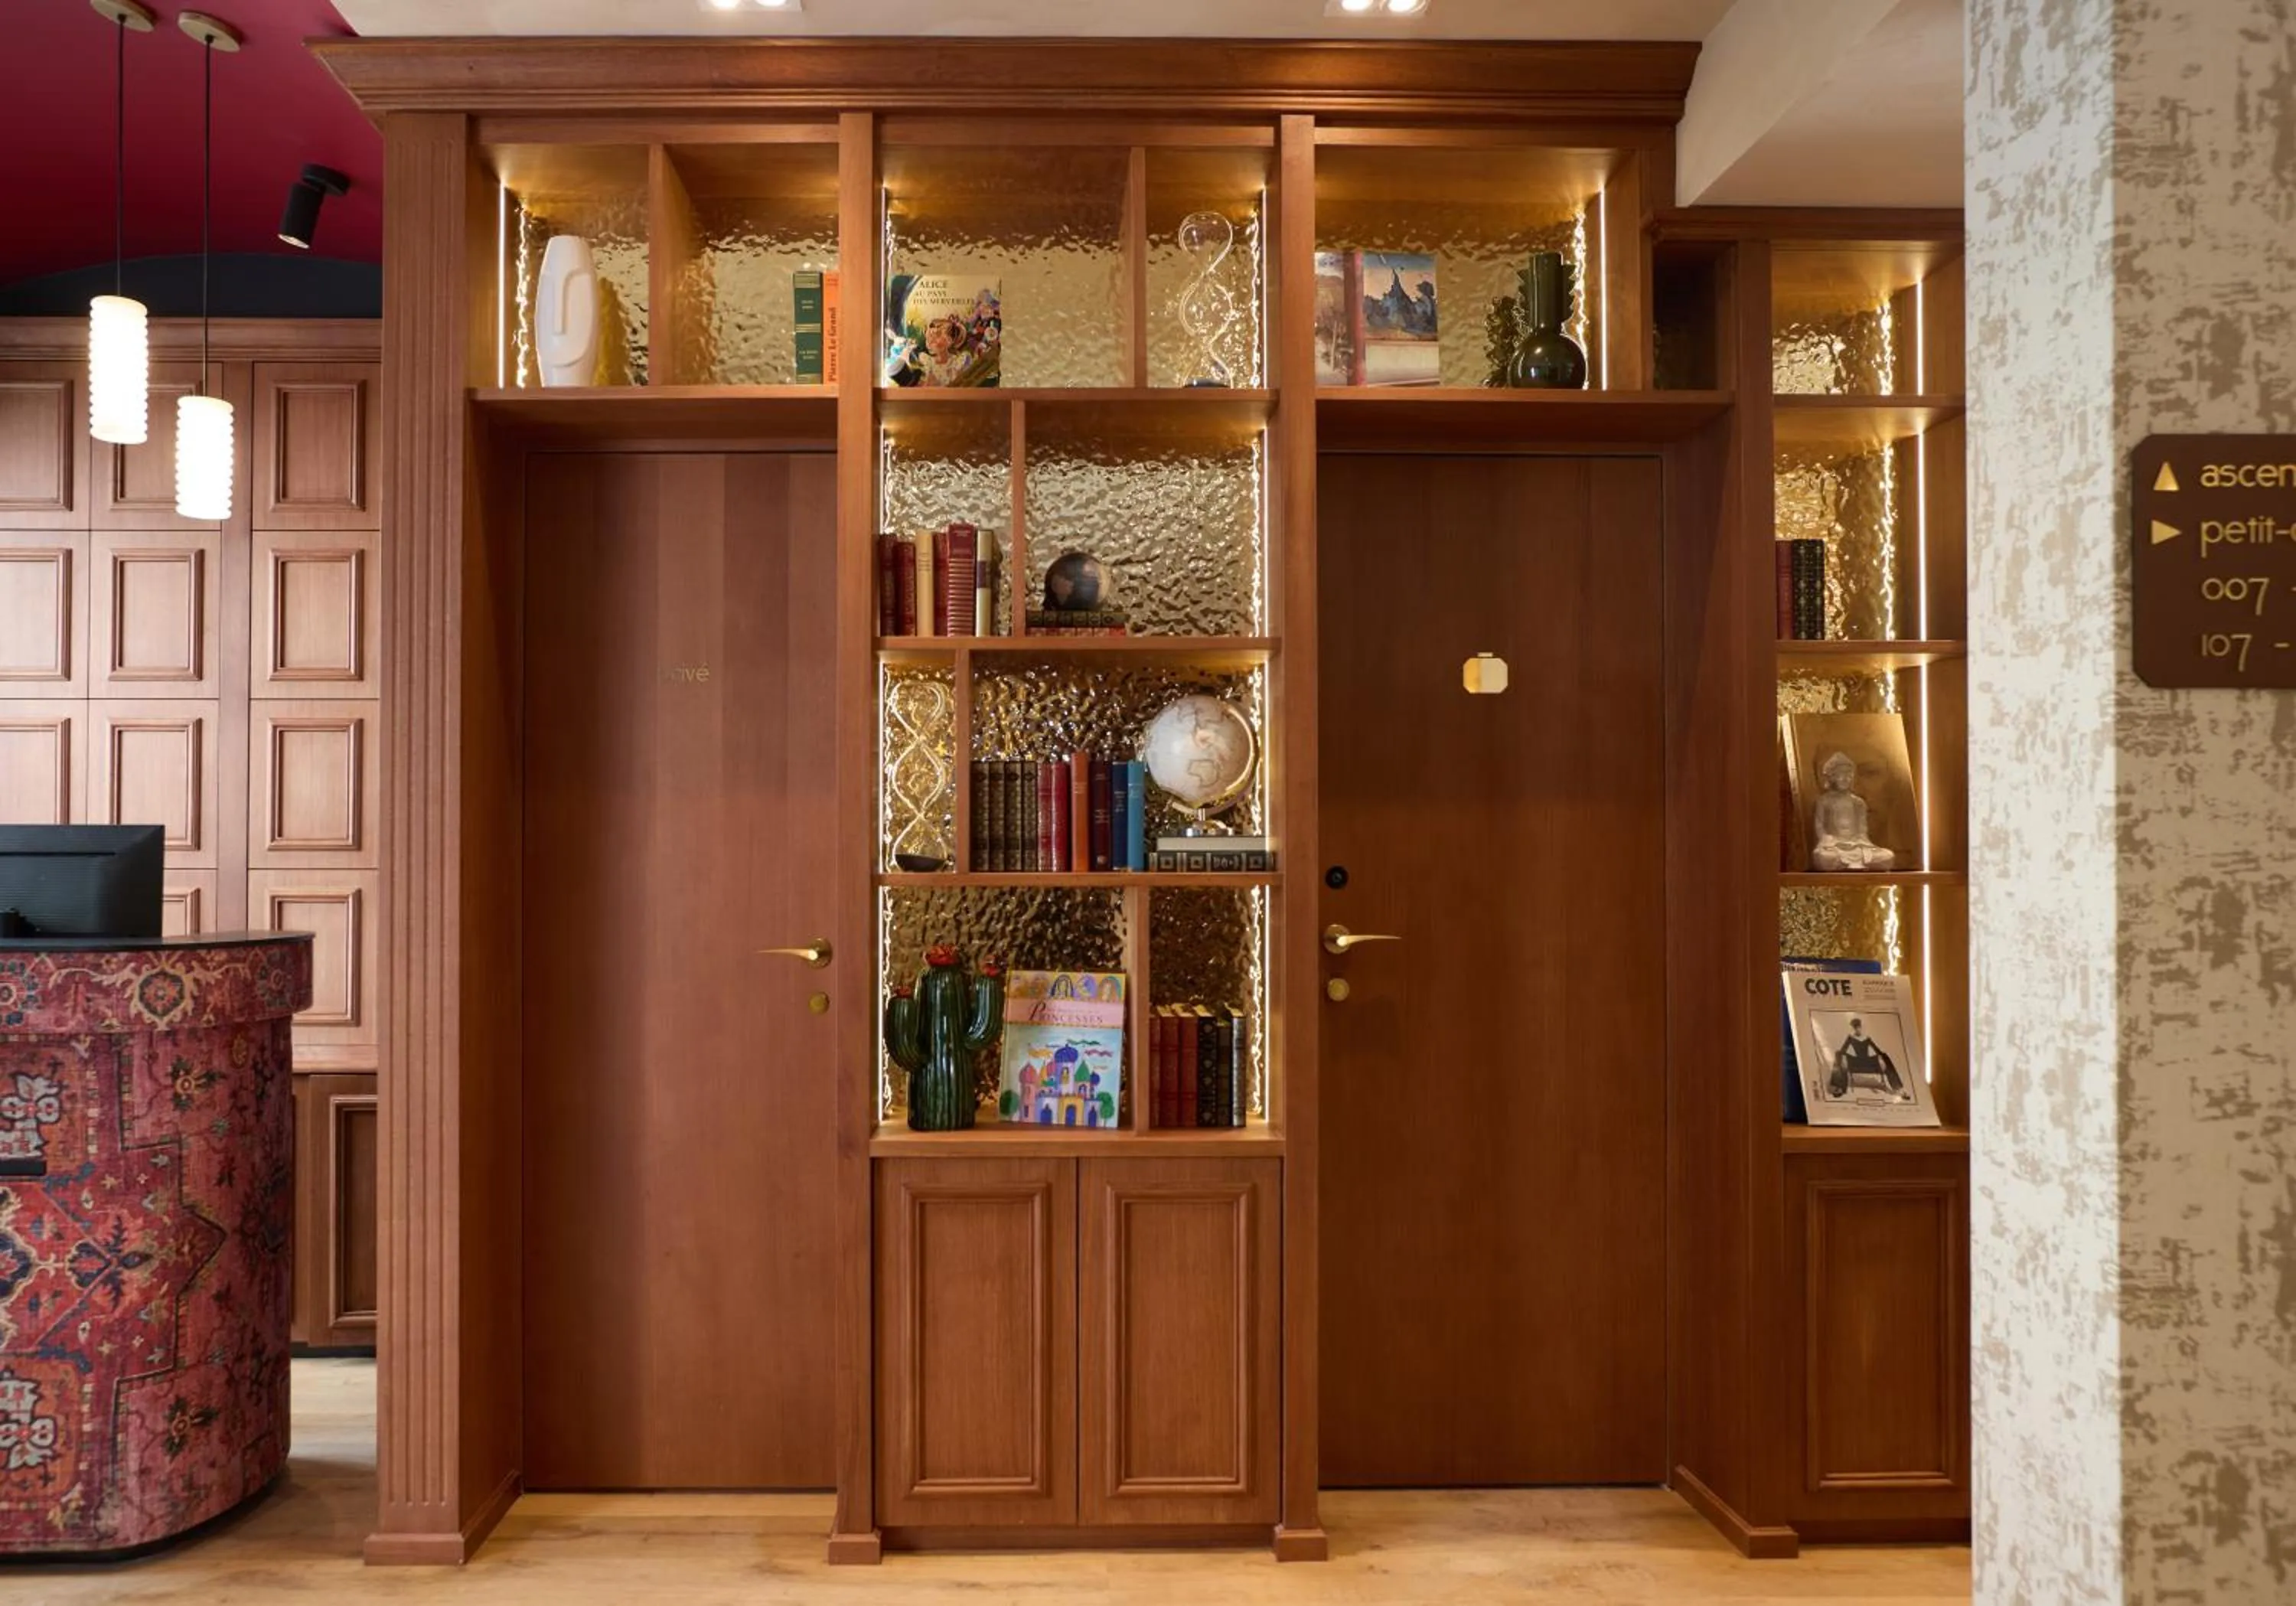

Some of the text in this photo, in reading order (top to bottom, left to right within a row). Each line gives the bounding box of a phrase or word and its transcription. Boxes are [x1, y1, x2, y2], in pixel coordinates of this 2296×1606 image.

[827, 307, 837, 337] Grand
[827, 352, 837, 382] Pierre
[2200, 464, 2296, 487] ascen
[2201, 577, 2269, 615] 007
[1805, 978, 1852, 996] COTE
